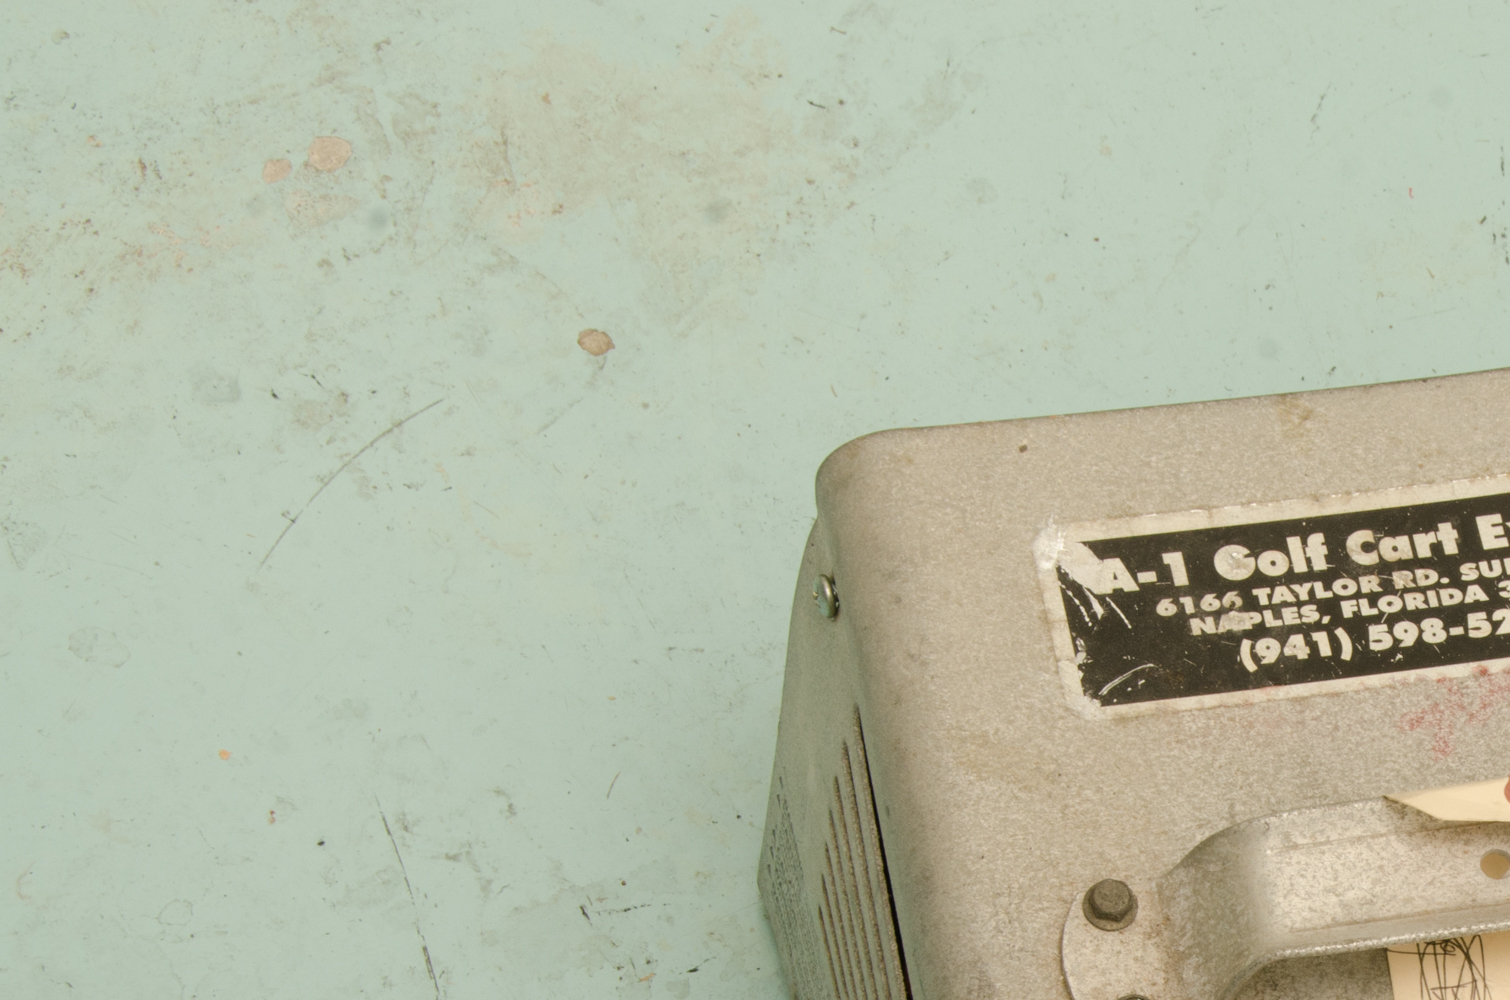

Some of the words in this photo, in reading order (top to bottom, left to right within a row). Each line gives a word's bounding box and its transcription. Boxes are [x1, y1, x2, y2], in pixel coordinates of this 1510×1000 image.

[1092, 551, 1190, 595] A-1
[1213, 532, 1329, 581] Golf
[1345, 521, 1460, 566] Cart
[1155, 590, 1244, 617] 6166
[1251, 574, 1383, 606] TAYLOR
[1391, 567, 1450, 590] RD.
[1189, 604, 1332, 636] NAPLES,
[1340, 583, 1490, 618] FLORIDA
[1239, 626, 1353, 673] (941)
